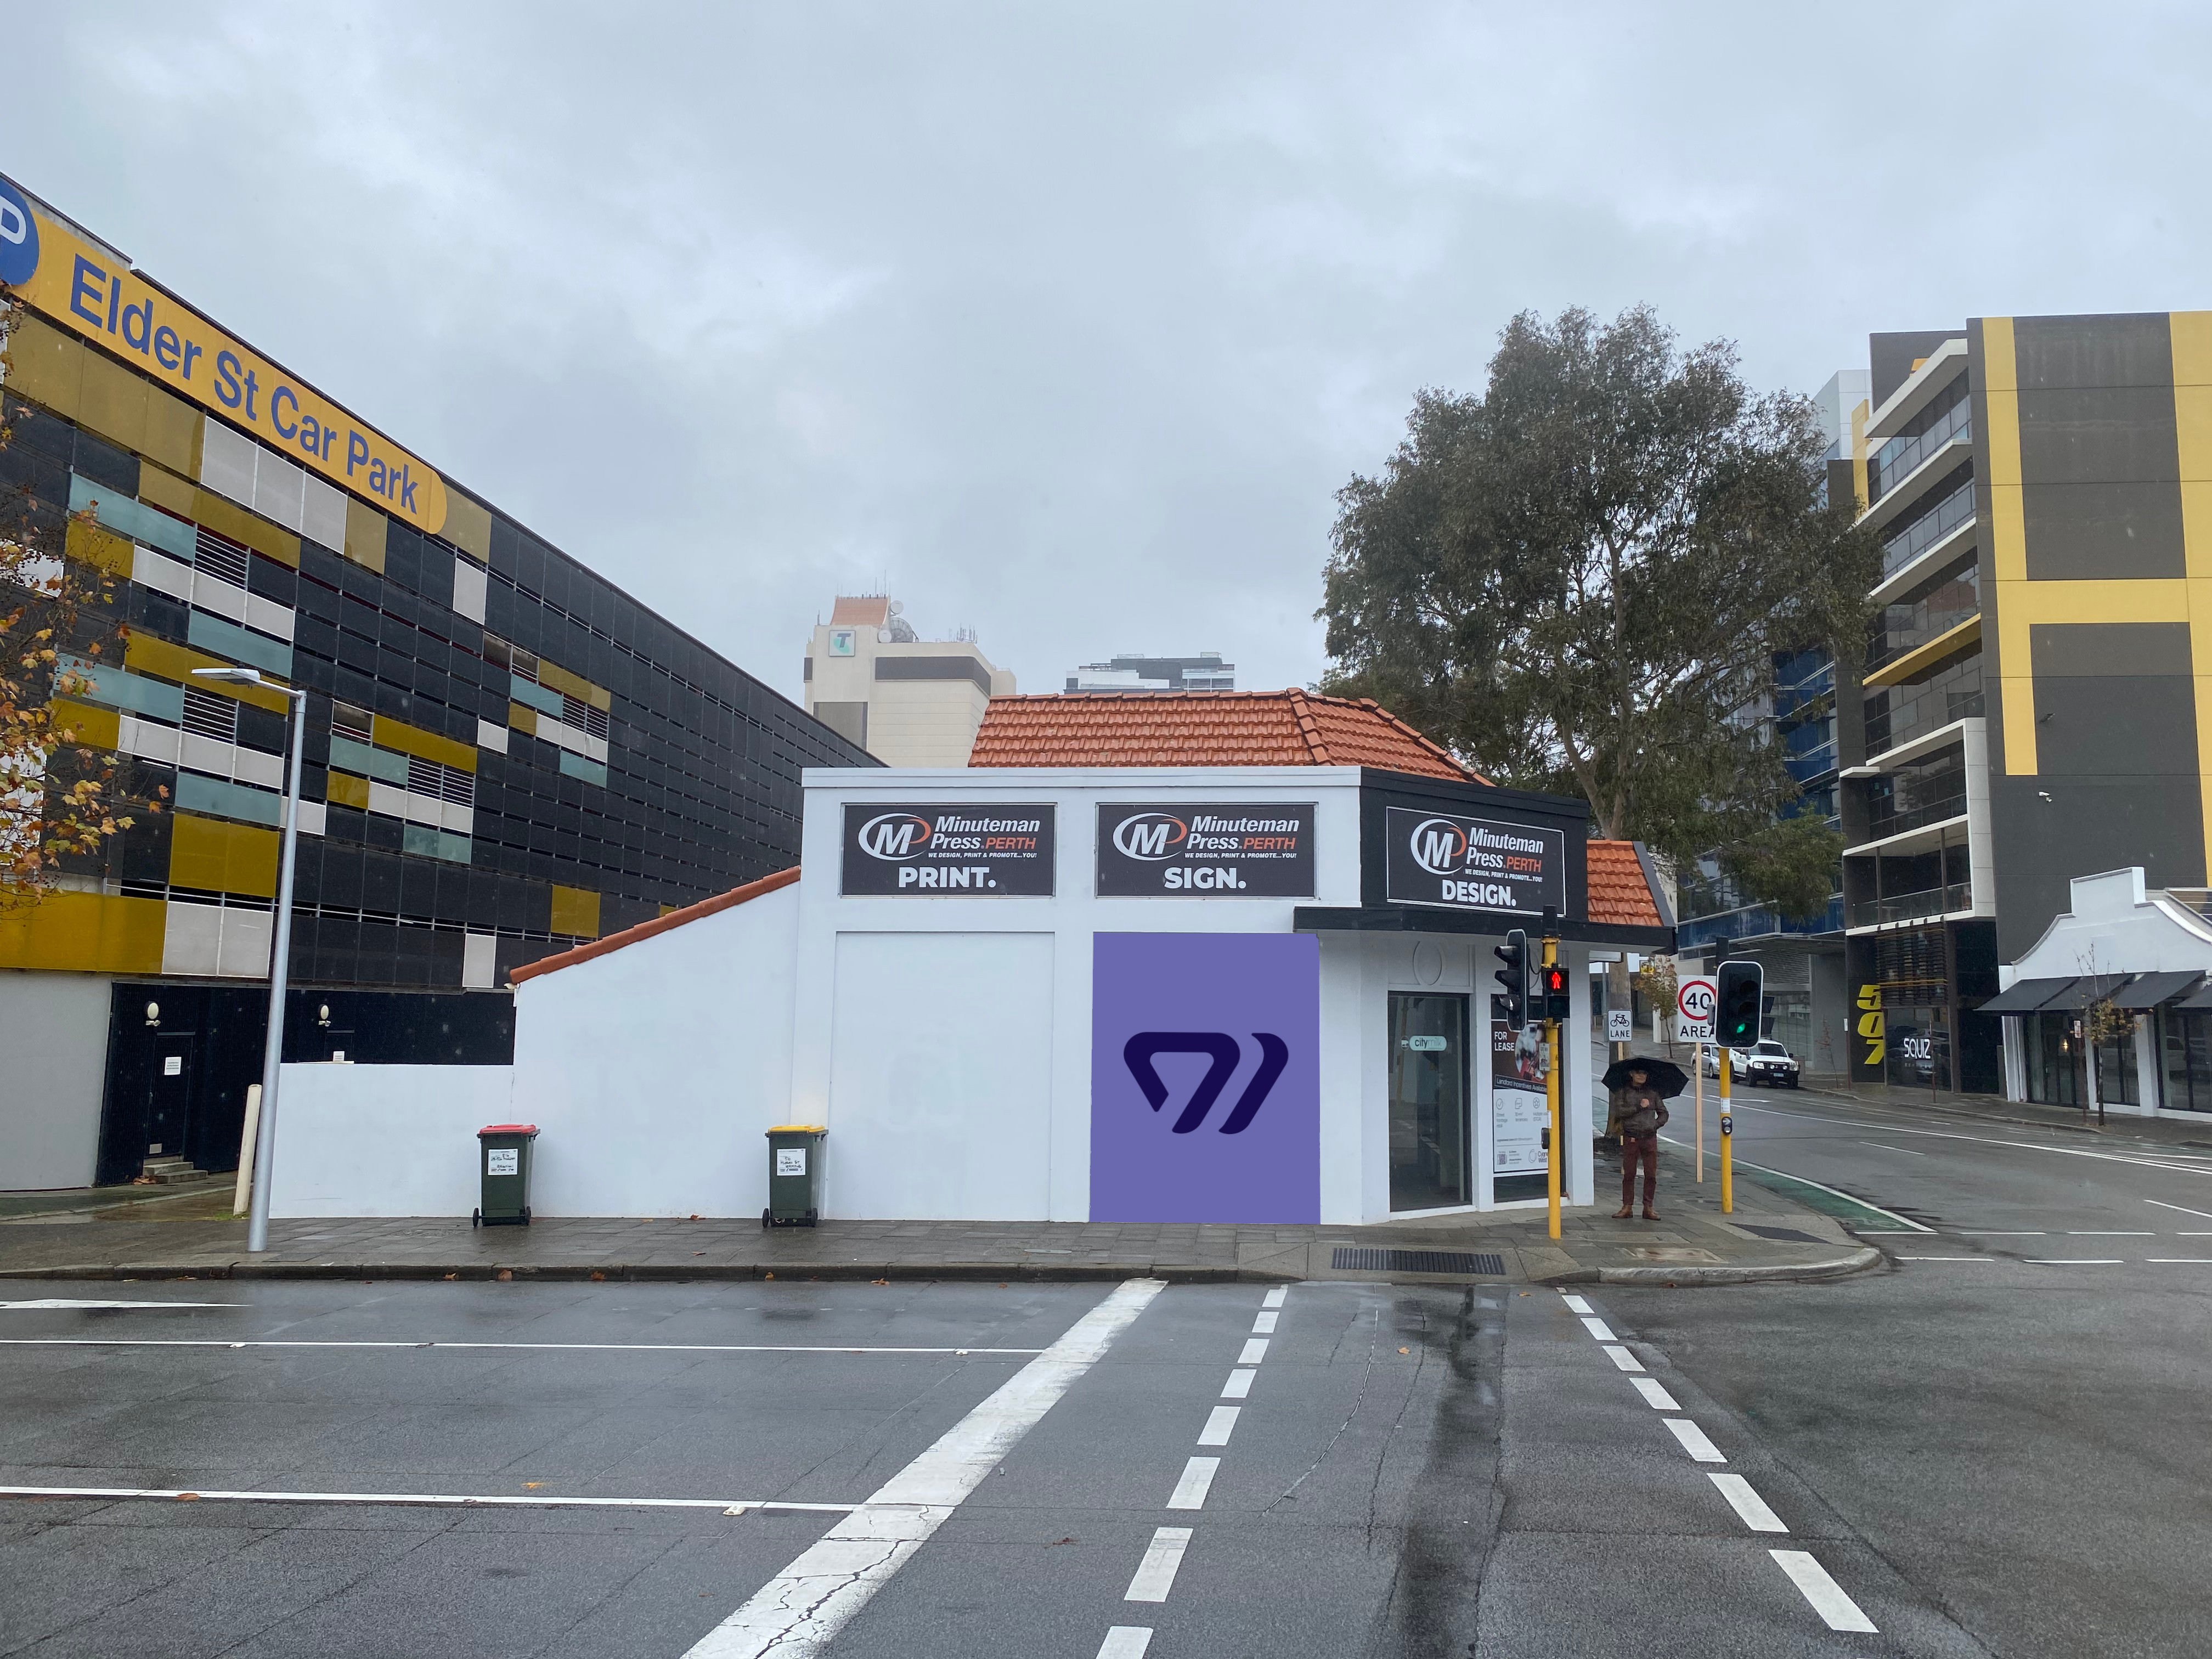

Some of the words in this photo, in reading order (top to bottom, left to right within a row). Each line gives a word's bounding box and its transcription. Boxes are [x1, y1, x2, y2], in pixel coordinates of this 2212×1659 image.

[70, 253, 202, 380] Elder
[214, 351, 258, 421] St
[271, 386, 336, 462] Car
[347, 430, 418, 515] Park
[935, 816, 1040, 832] Minuteman
[1191, 816, 1299, 832] Minuteman
[1469, 827, 1544, 854] Minuteman
[899, 867, 996, 888] PRINT.
[1164, 867, 1246, 889] SIGN.
[1442, 879, 1517, 907] DESIGN.
[1685, 992, 1712, 1010] 40
[1857, 985, 1885, 1064] 507
[1494, 1031, 1508, 1040] FOR
[1494, 1042, 1514, 1051] LEASE
